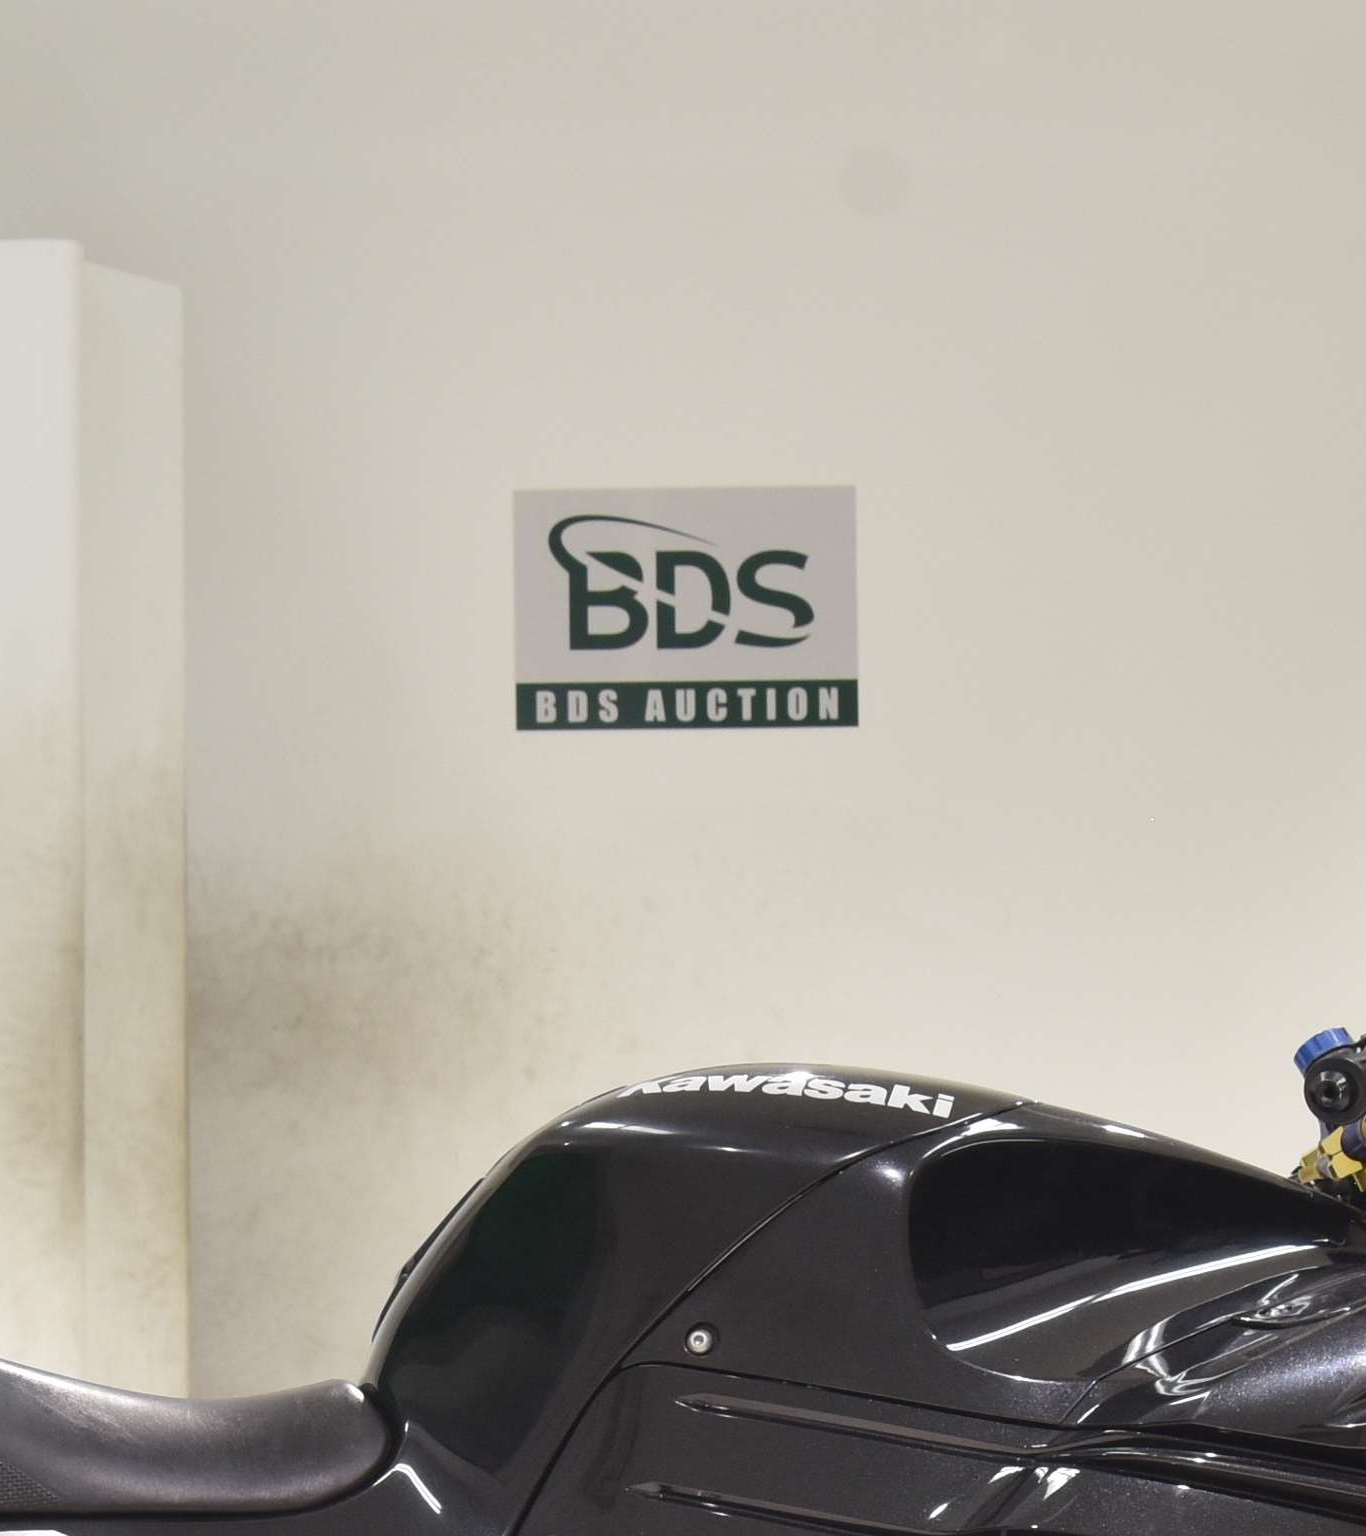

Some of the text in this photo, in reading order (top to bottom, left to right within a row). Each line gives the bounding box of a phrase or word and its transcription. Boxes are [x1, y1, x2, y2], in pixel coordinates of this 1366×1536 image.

[548, 514, 815, 651] BDS
[535, 687, 840, 724] BDS AUCTION
